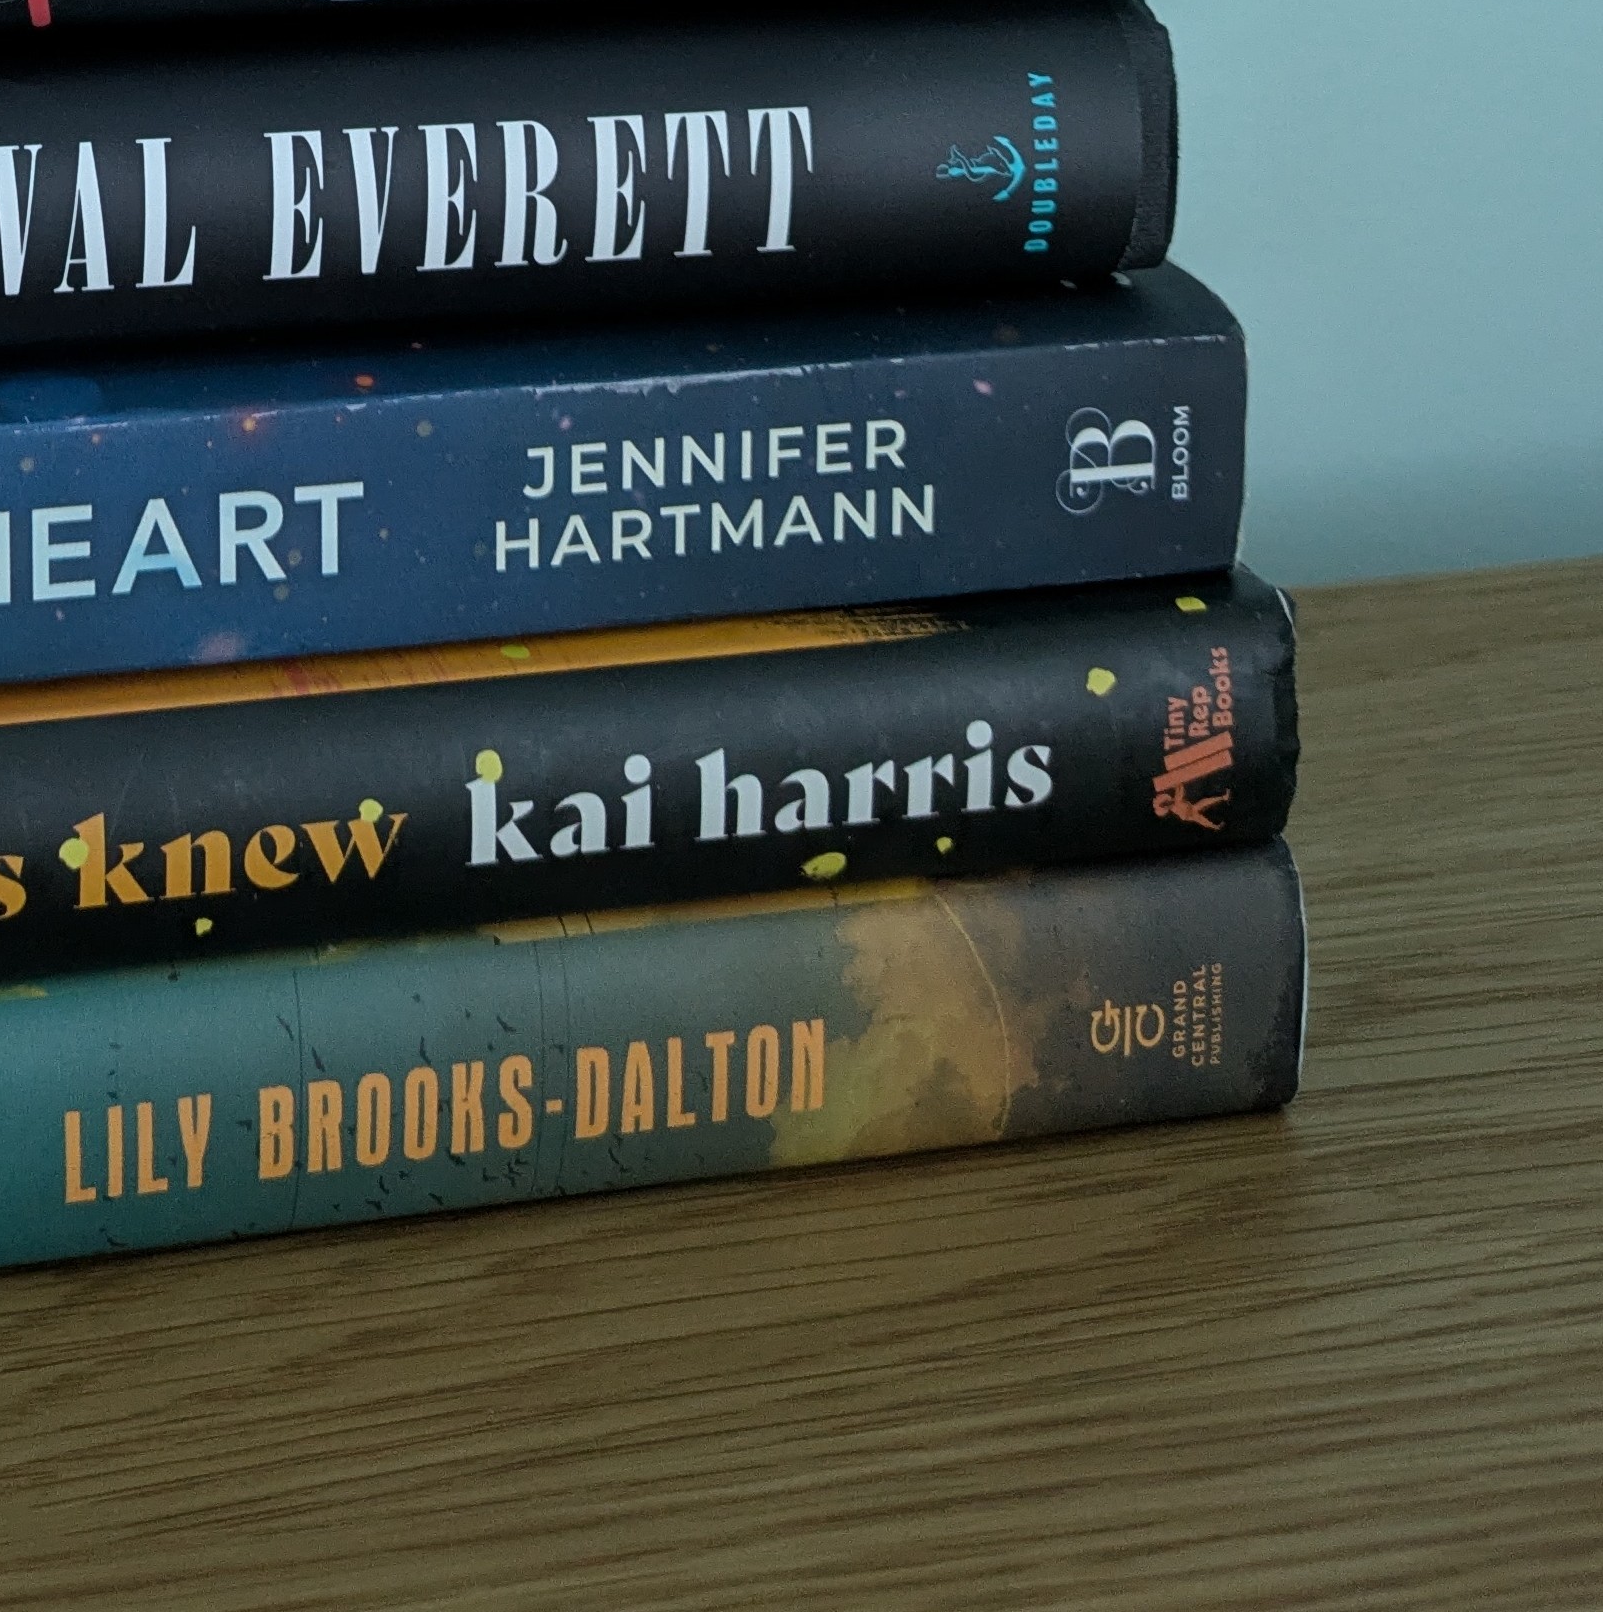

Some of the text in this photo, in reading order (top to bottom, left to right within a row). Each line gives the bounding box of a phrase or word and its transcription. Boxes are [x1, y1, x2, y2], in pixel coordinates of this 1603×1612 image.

[263, 105, 814, 284] EVERETT
[1024, 72, 1059, 251] DOUBLEDAY
[522, 418, 908, 501] JENNIFER
[1172, 406, 1190, 500] BLOOM
[493, 483, 937, 573] HARTMANN
[1164, 696, 1188, 750] Tiny
[1188, 686, 1212, 737] Rep
[1209, 647, 1233, 726] Books
[464, 718, 1055, 869] kai harris
[69, 811, 408, 912] knew
[1173, 980, 1187, 1057] GRAND
[1191, 964, 1206, 1067] CENTRAL
[1210, 963, 1222, 1065] PUBLISHING
[63, 1017, 827, 1204] LILY BROOKS-DALTON
